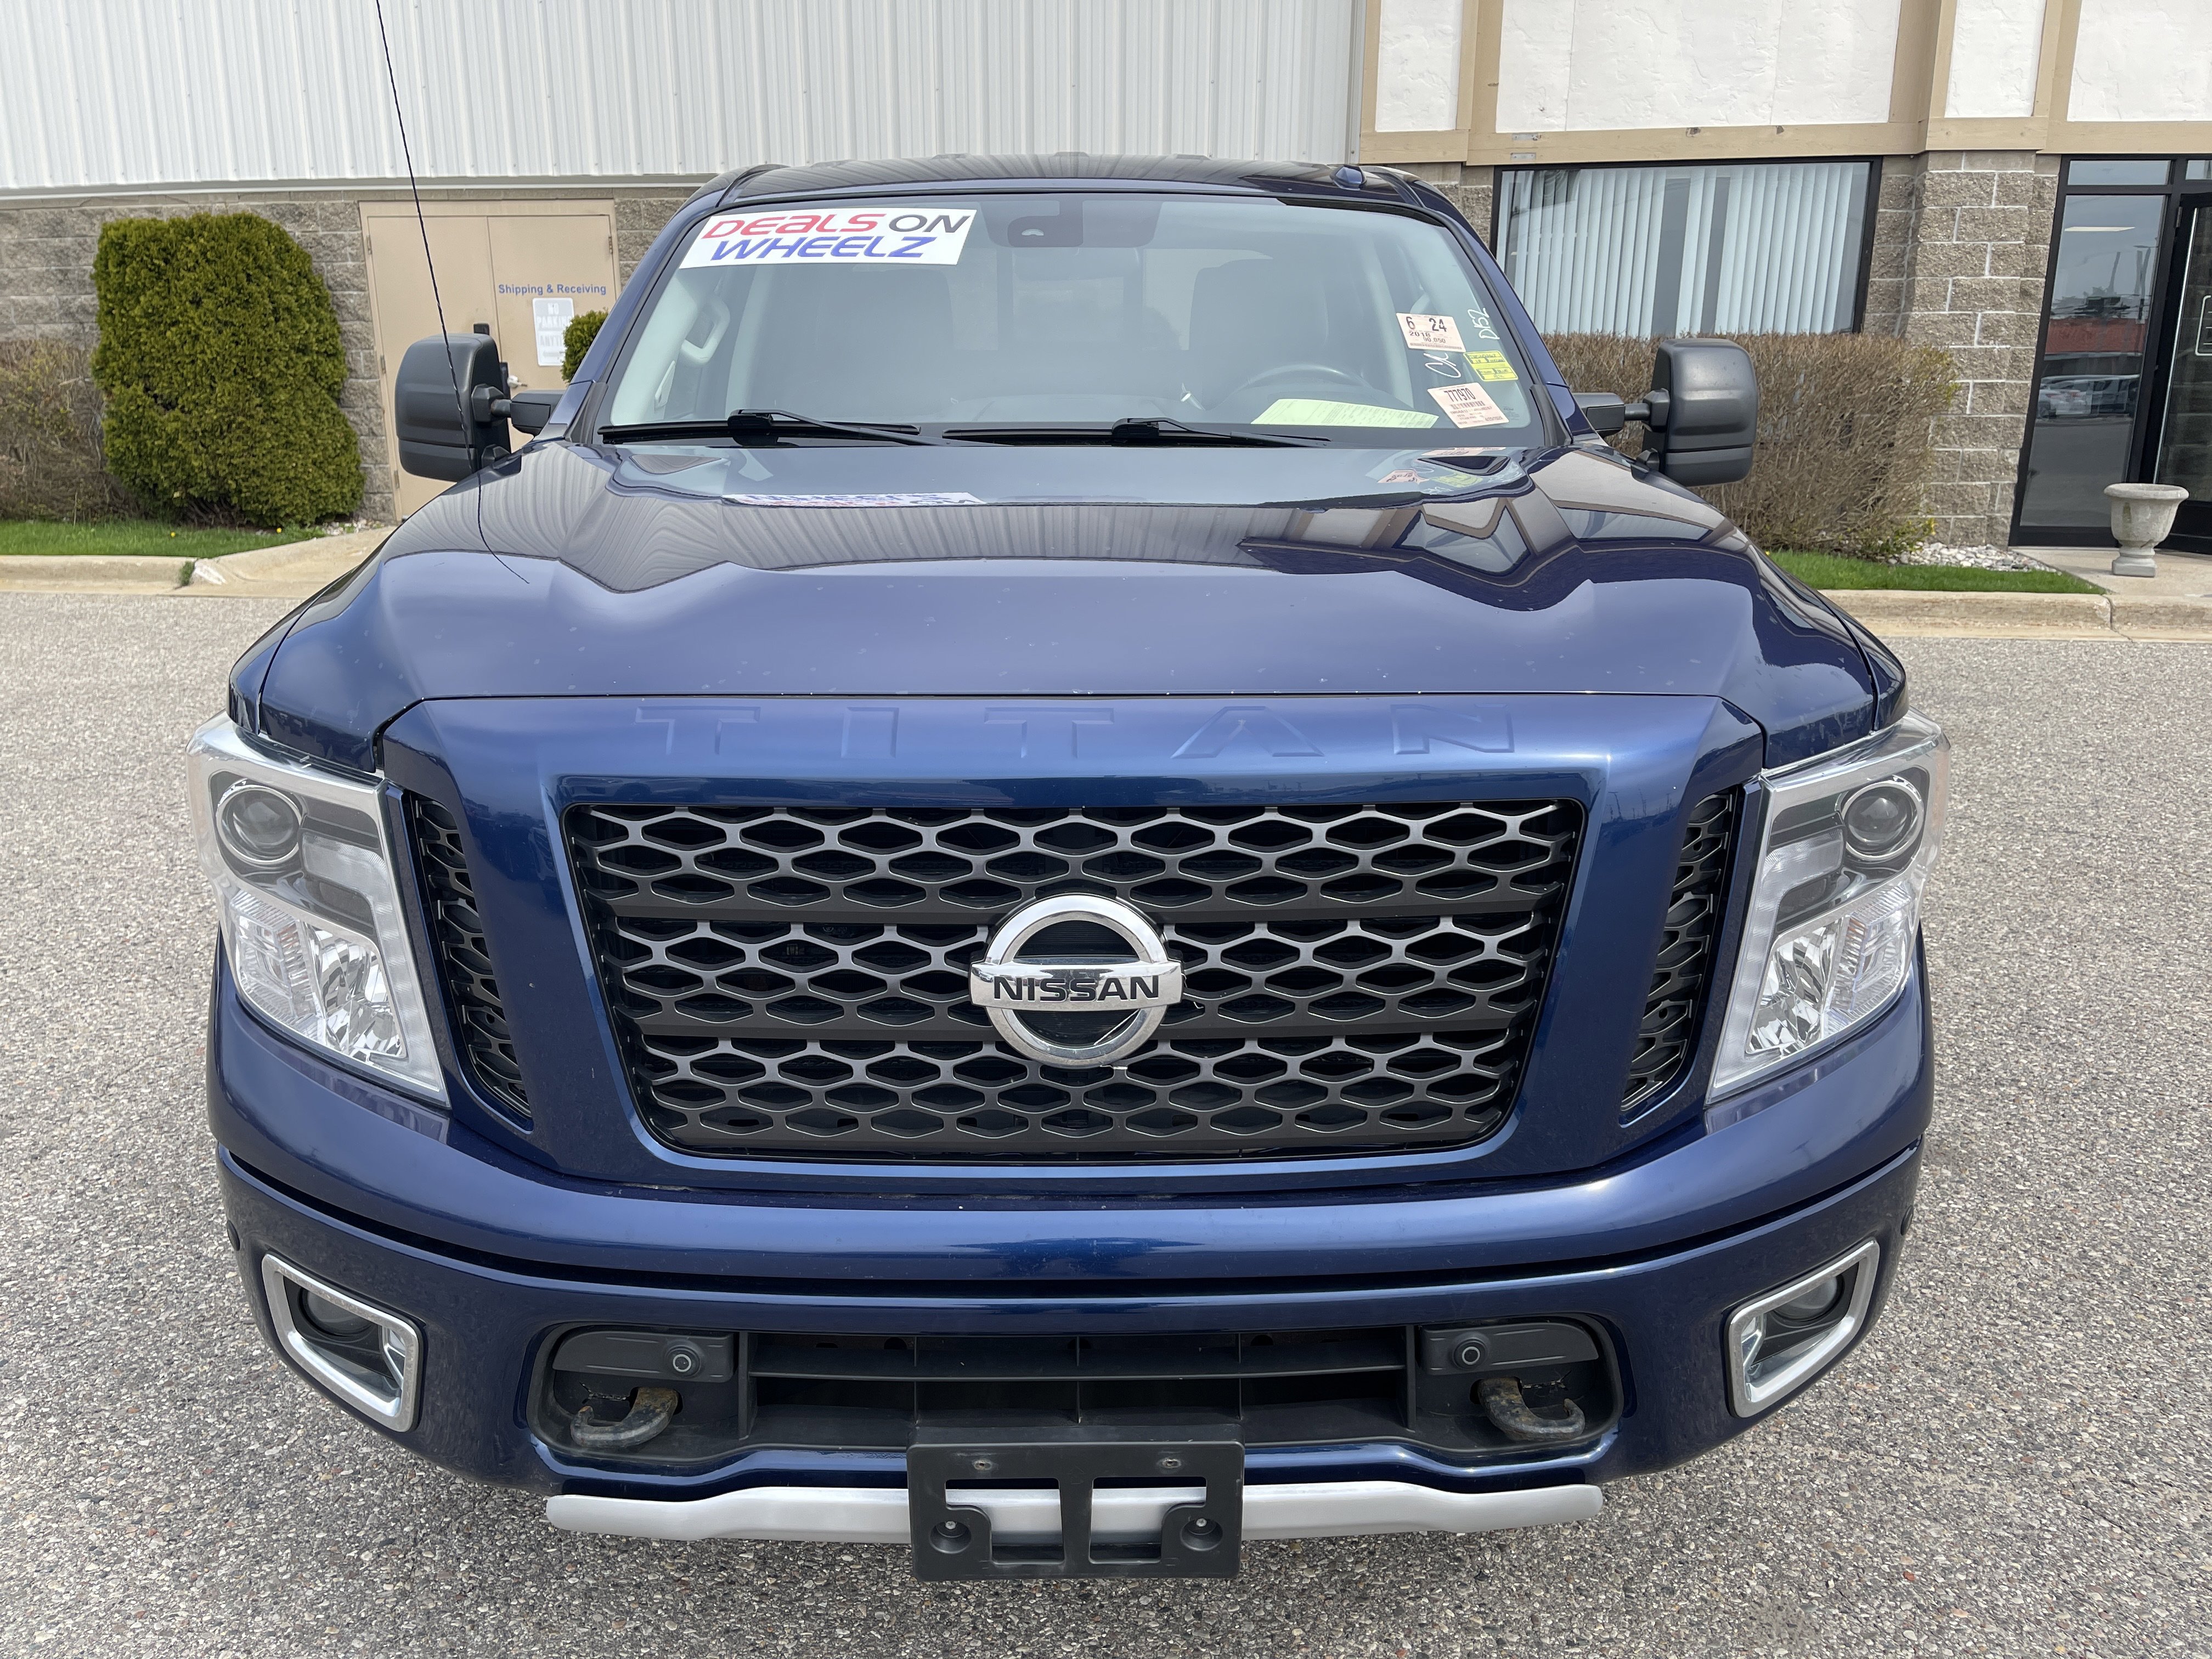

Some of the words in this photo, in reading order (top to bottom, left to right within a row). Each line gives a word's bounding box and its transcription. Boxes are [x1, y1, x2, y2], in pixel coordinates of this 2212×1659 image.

[888, 214, 972, 234] ON
[710, 236, 938, 262] WHEELZ
[498, 284, 544, 296] Shipping
[546, 284, 554, 293] &
[557, 284, 607, 295] Receiving
[1406, 316, 1416, 330] 6
[1429, 318, 1447, 332] 24
[1443, 387, 1476, 402] 777970
[634, 703, 1516, 759] TITAN
[994, 974, 1159, 1002] NISSAN
